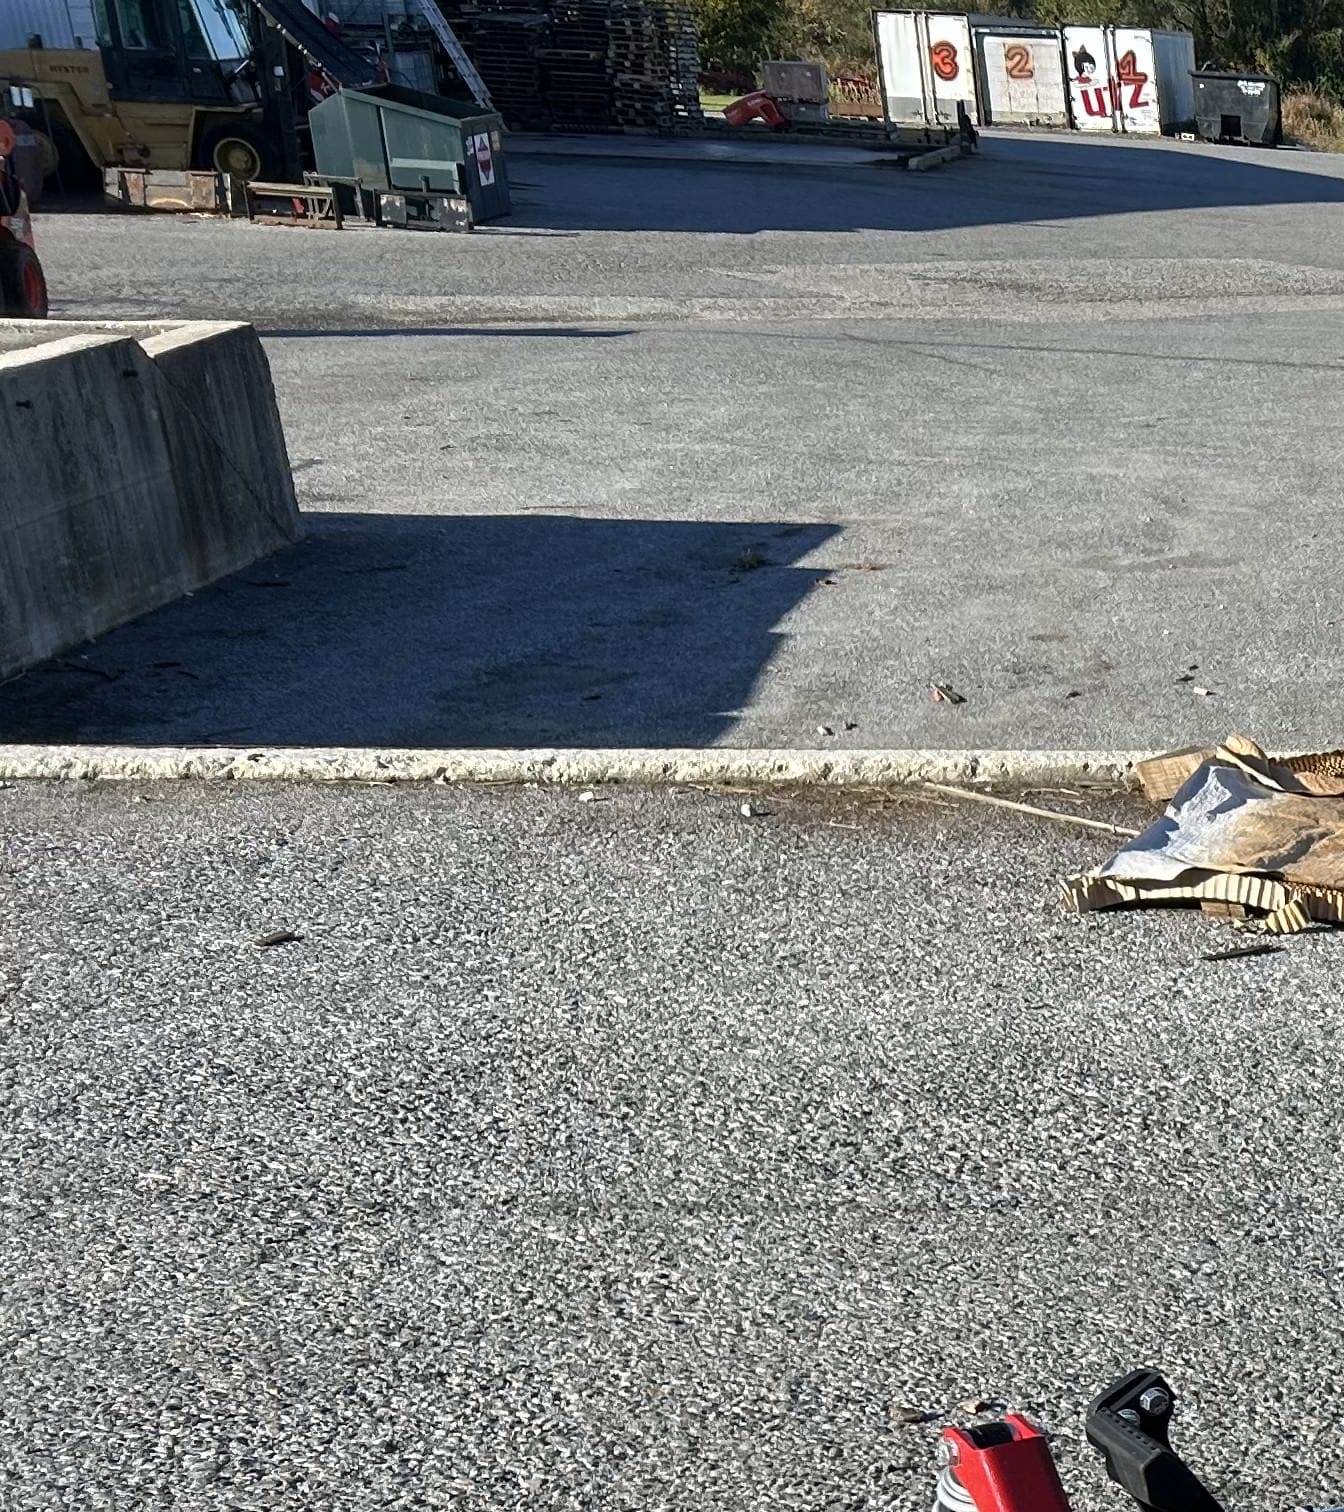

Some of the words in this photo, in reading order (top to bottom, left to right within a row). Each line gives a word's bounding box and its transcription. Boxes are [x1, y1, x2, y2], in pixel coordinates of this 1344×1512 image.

[932, 40, 958, 80] 3
[1005, 44, 1033, 79] 2
[1118, 50, 1148, 84] 1
